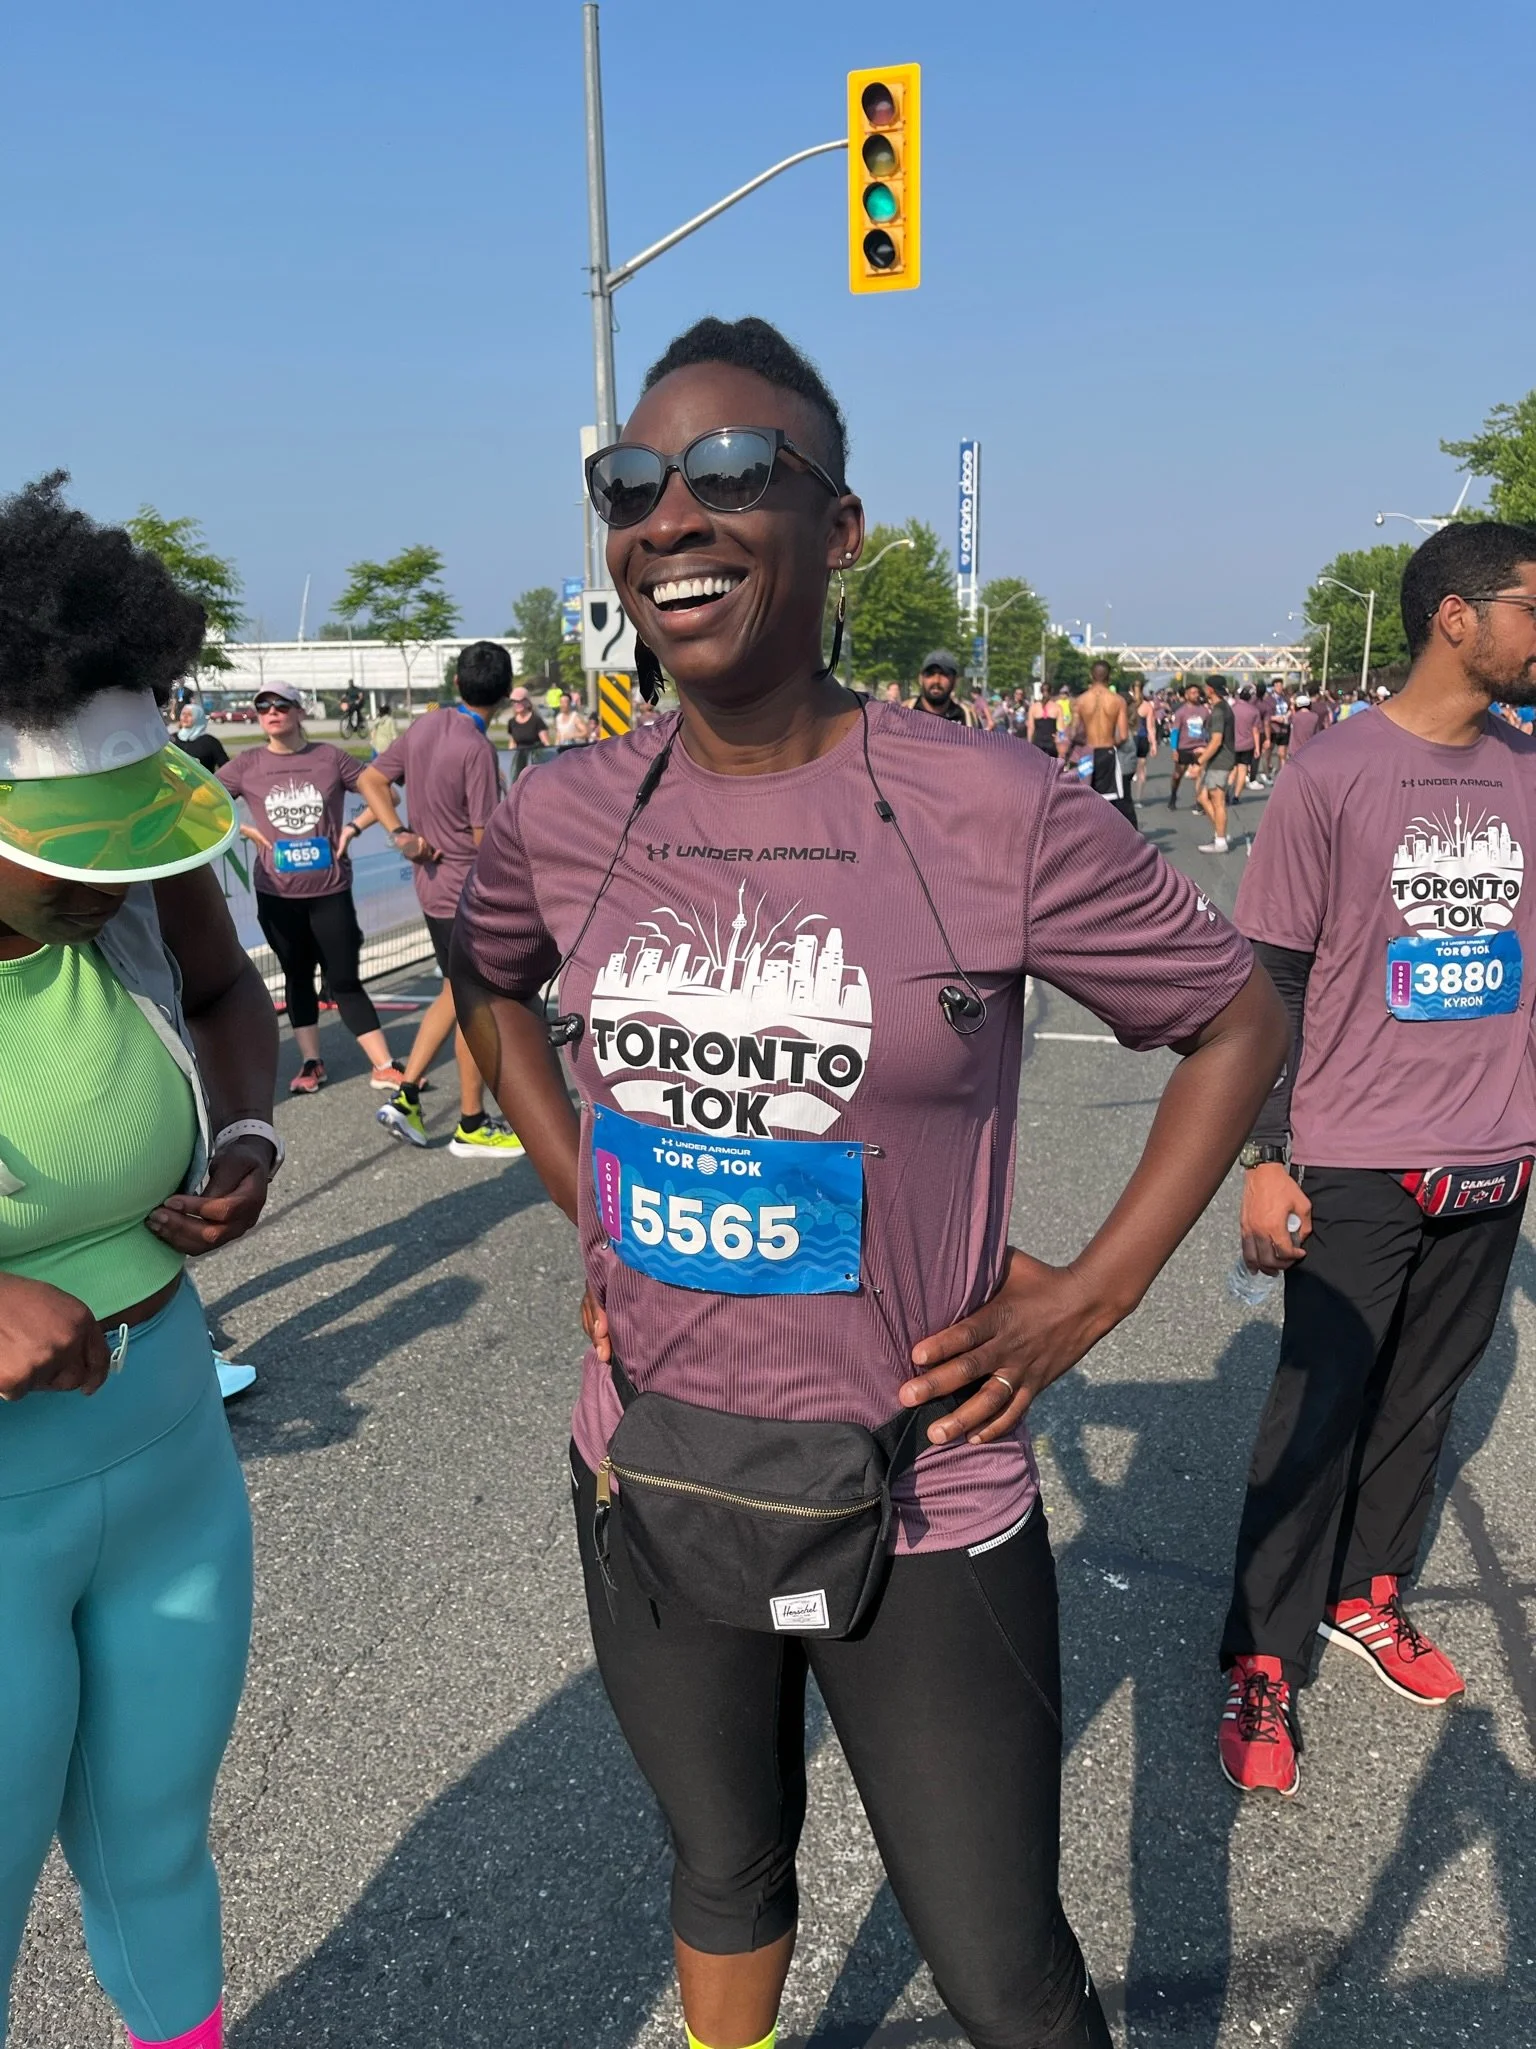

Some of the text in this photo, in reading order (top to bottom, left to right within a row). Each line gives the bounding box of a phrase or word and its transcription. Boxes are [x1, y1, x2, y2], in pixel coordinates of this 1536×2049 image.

[959, 449, 974, 553] ontario place
[1418, 779, 1503, 788] UNDER ARMOUR
[284, 847, 320, 862] 1659
[676, 846, 857, 863] UNDER ARMOUR
[1393, 877, 1520, 900] TORONTO
[1434, 905, 1484, 927] 10K
[1414, 959, 1503, 995] 3880
[1444, 996, 1483, 1008] KYRON
[592, 1018, 863, 1087] TORONTO
[662, 1084, 773, 1137] 10K
[676, 1141, 751, 1156] UNDER ARMOUR
[605, 1163, 614, 1224] CORRAL
[1461, 1175, 1506, 1190] CANADA
[631, 1184, 801, 1260] 5565
[783, 1602, 817, 1617] Herschel
